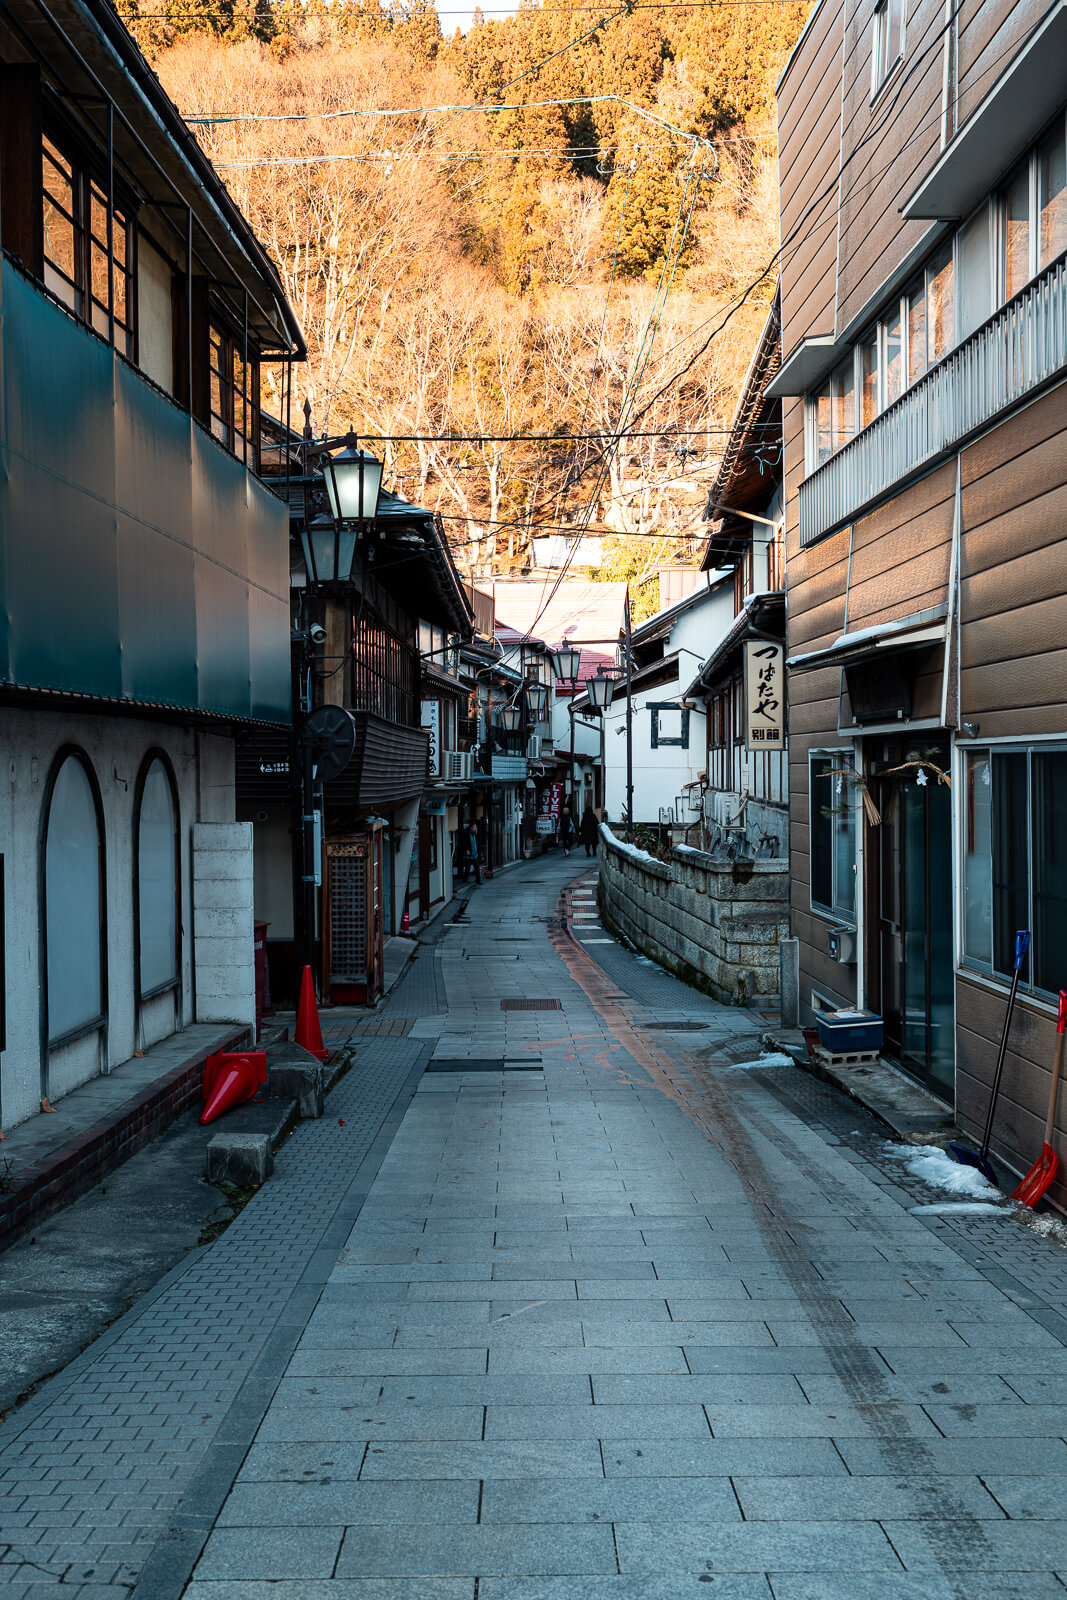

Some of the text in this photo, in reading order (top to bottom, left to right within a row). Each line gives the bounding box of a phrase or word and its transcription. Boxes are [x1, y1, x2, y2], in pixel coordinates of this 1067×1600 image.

[752, 645, 779, 723] つばたや
[751, 728, 780, 740] 別館
